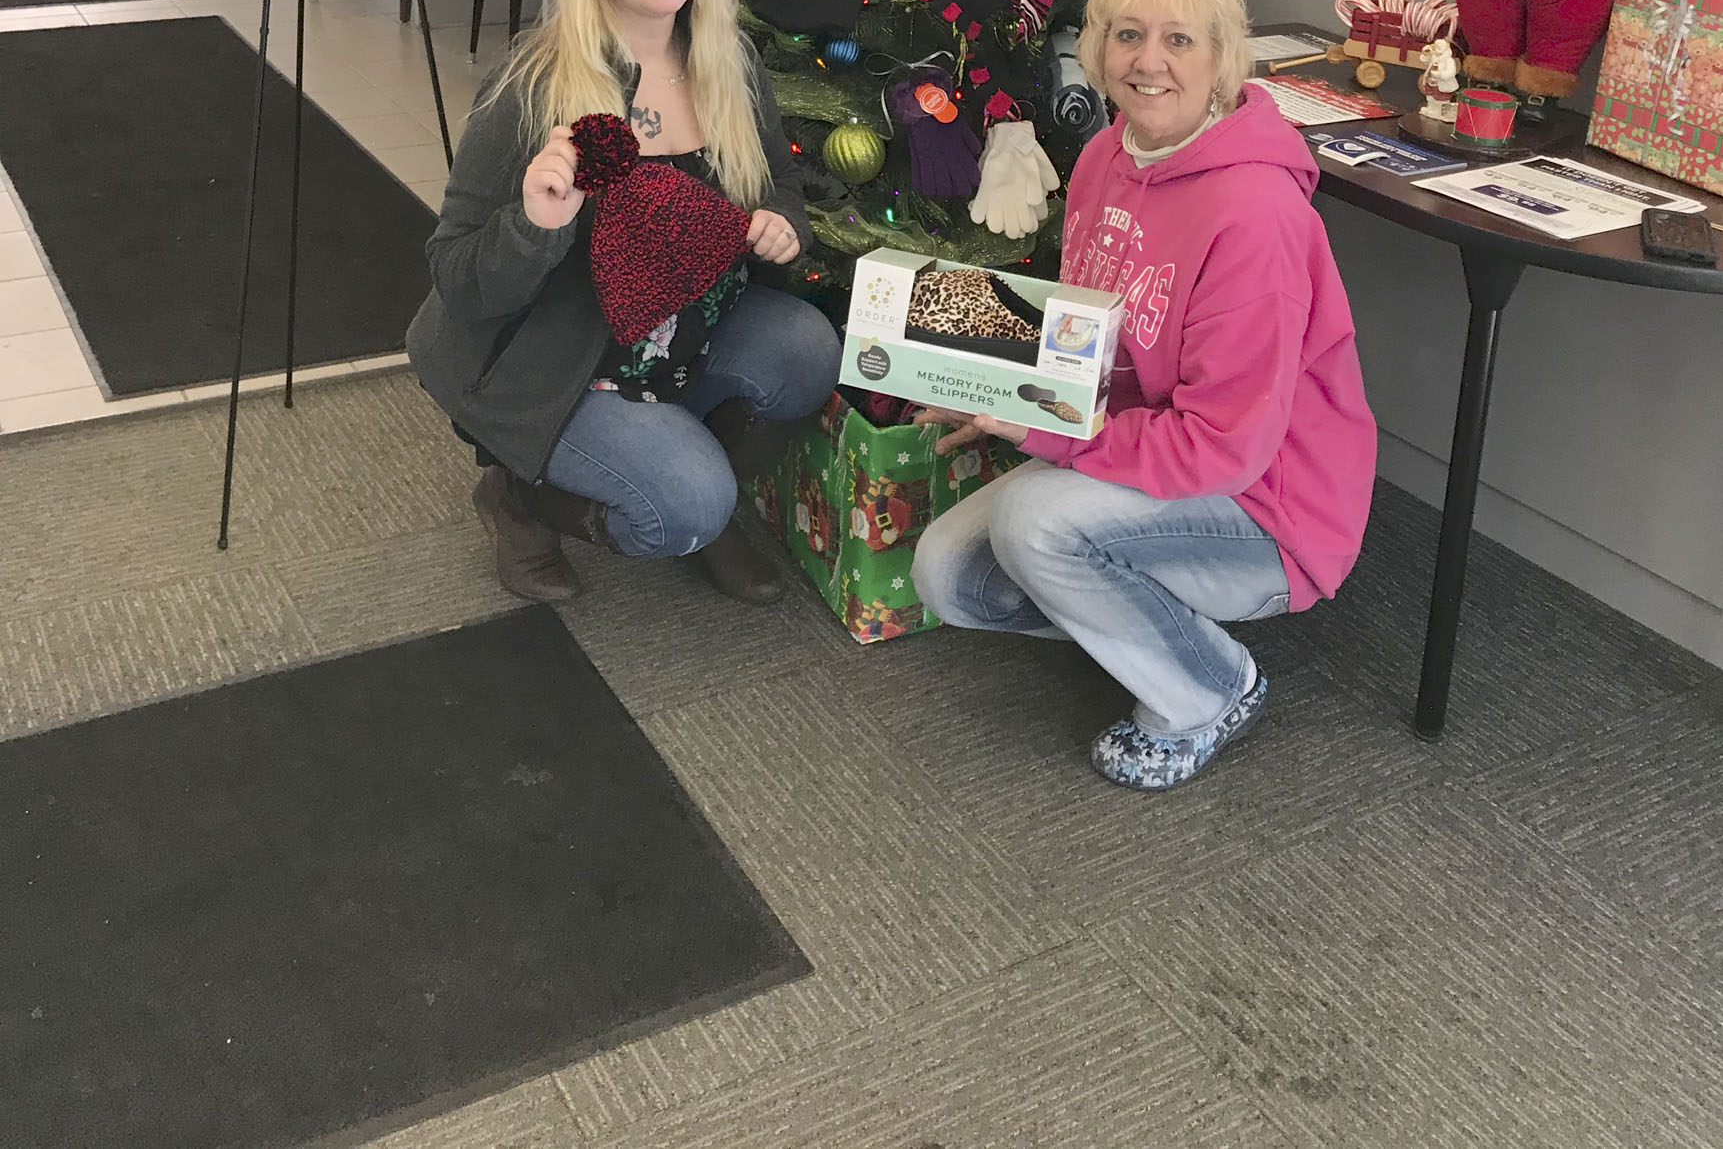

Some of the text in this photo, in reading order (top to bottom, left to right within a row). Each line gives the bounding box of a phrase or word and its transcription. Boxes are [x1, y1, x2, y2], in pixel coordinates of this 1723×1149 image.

[856, 309, 896, 324] ORDER
[944, 365, 986, 381] womens
[917, 370, 1012, 398] MEMORY FOAM
[930, 385, 994, 406] SLIPPERS
